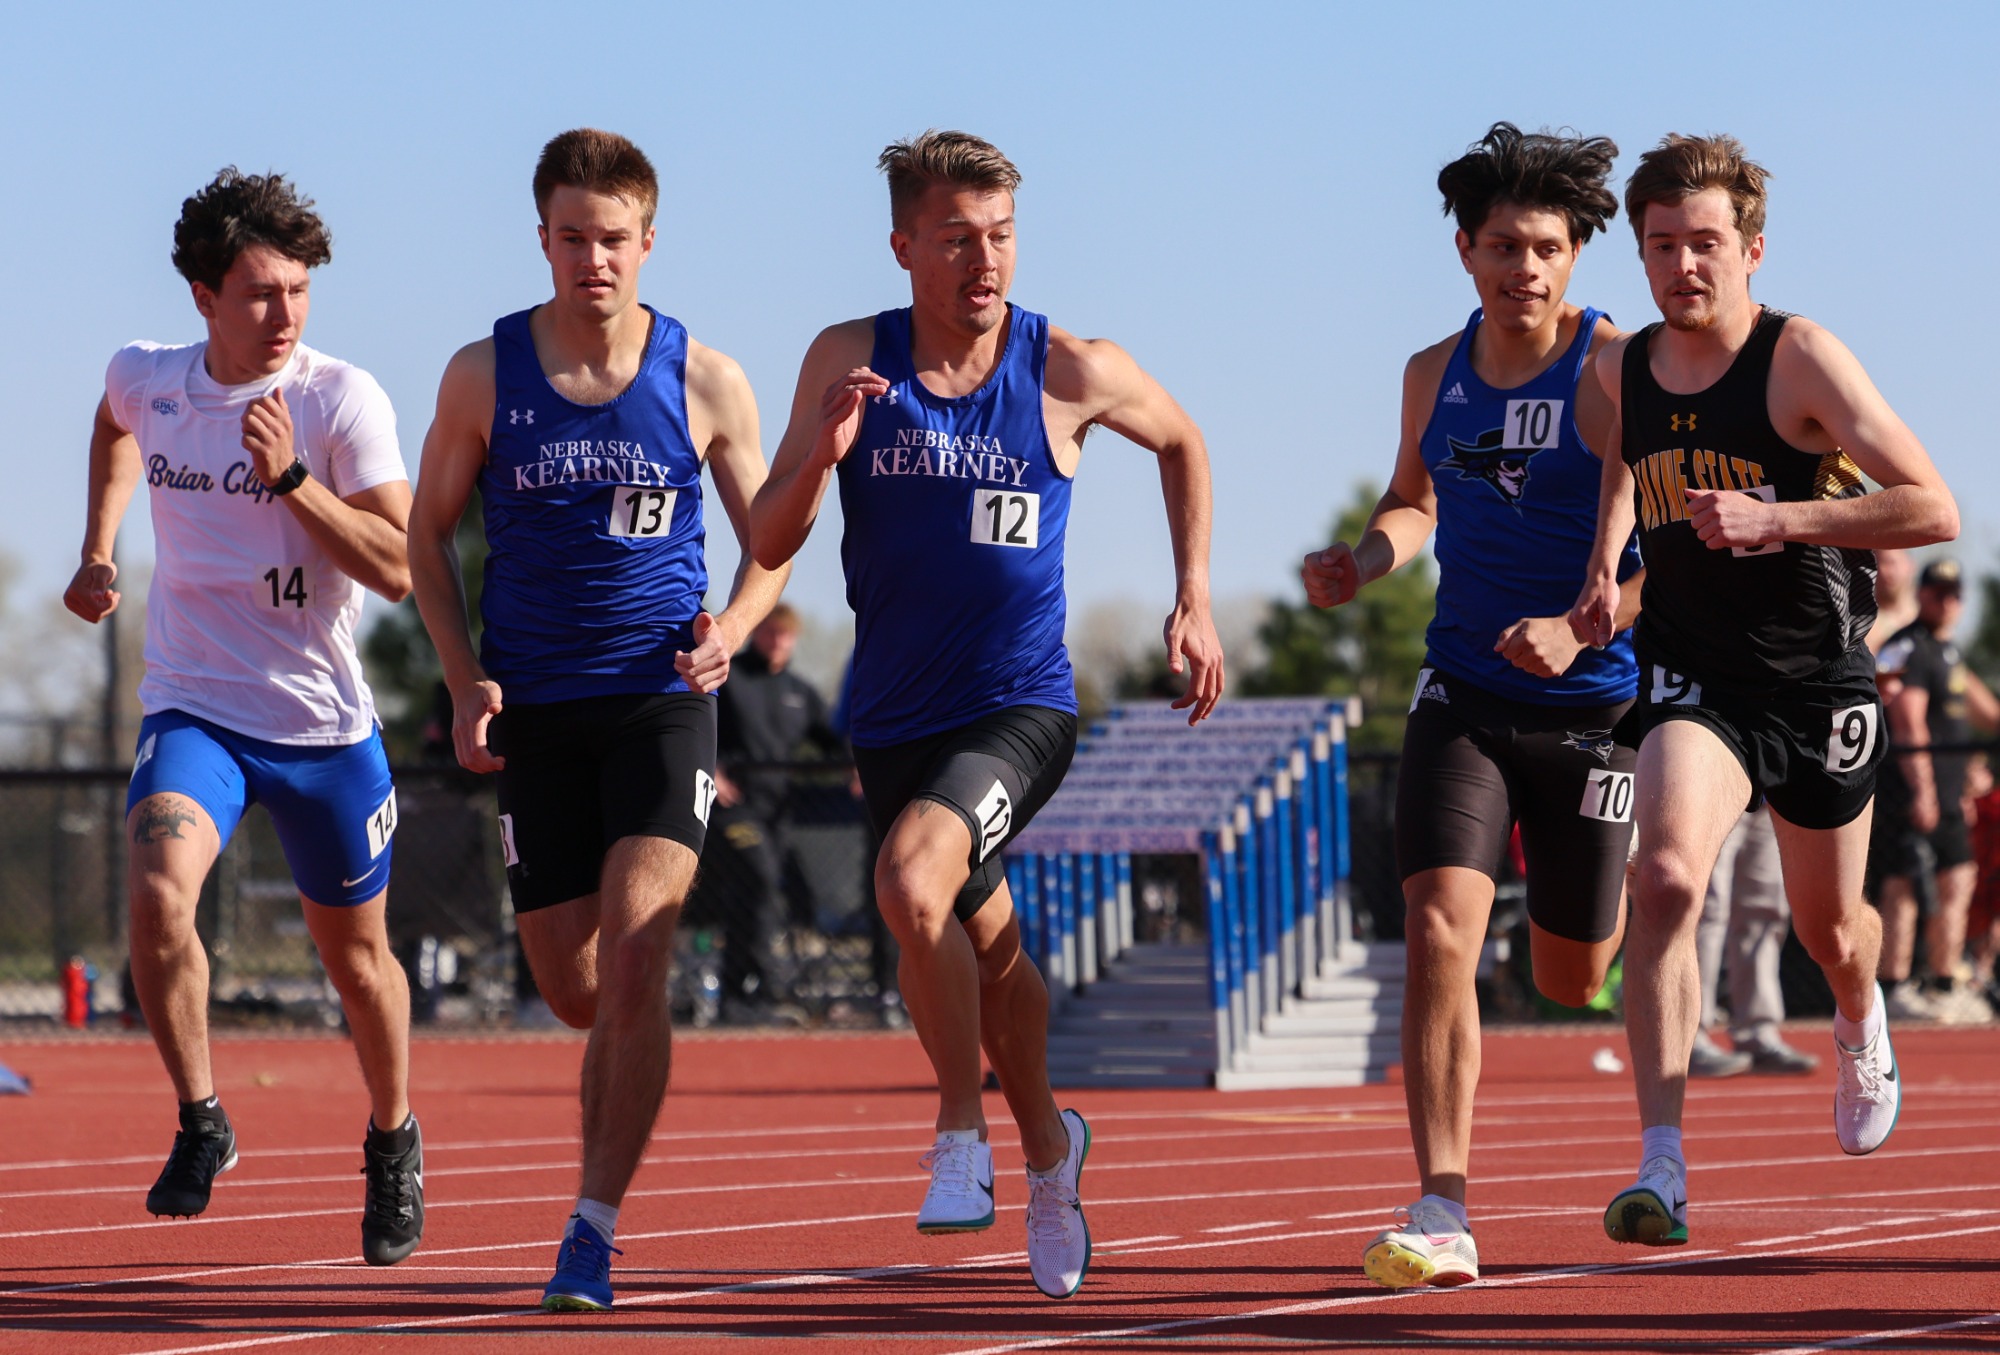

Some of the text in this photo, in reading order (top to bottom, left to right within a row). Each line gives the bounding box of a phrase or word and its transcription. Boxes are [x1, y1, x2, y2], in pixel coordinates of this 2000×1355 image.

[152, 399, 179, 415] GPAC
[1443, 394, 1468, 404] adidas
[895, 429, 1003, 454] NEBRASKA
[1515, 401, 1551, 446] 10
[539, 440, 645, 461] NEBRASKA
[870, 447, 1030, 487] KEARNEY
[147, 453, 274, 503] Briar Cli
[513, 457, 671, 491] KEARNEY
[625, 490, 666, 535] 13
[985, 494, 1028, 544] 12
[263, 566, 307, 608] 14
[1839, 710, 1867, 769] 9
[1597, 774, 1631, 820] 10
[374, 797, 393, 847] 14
[982, 797, 1010, 852] 12
